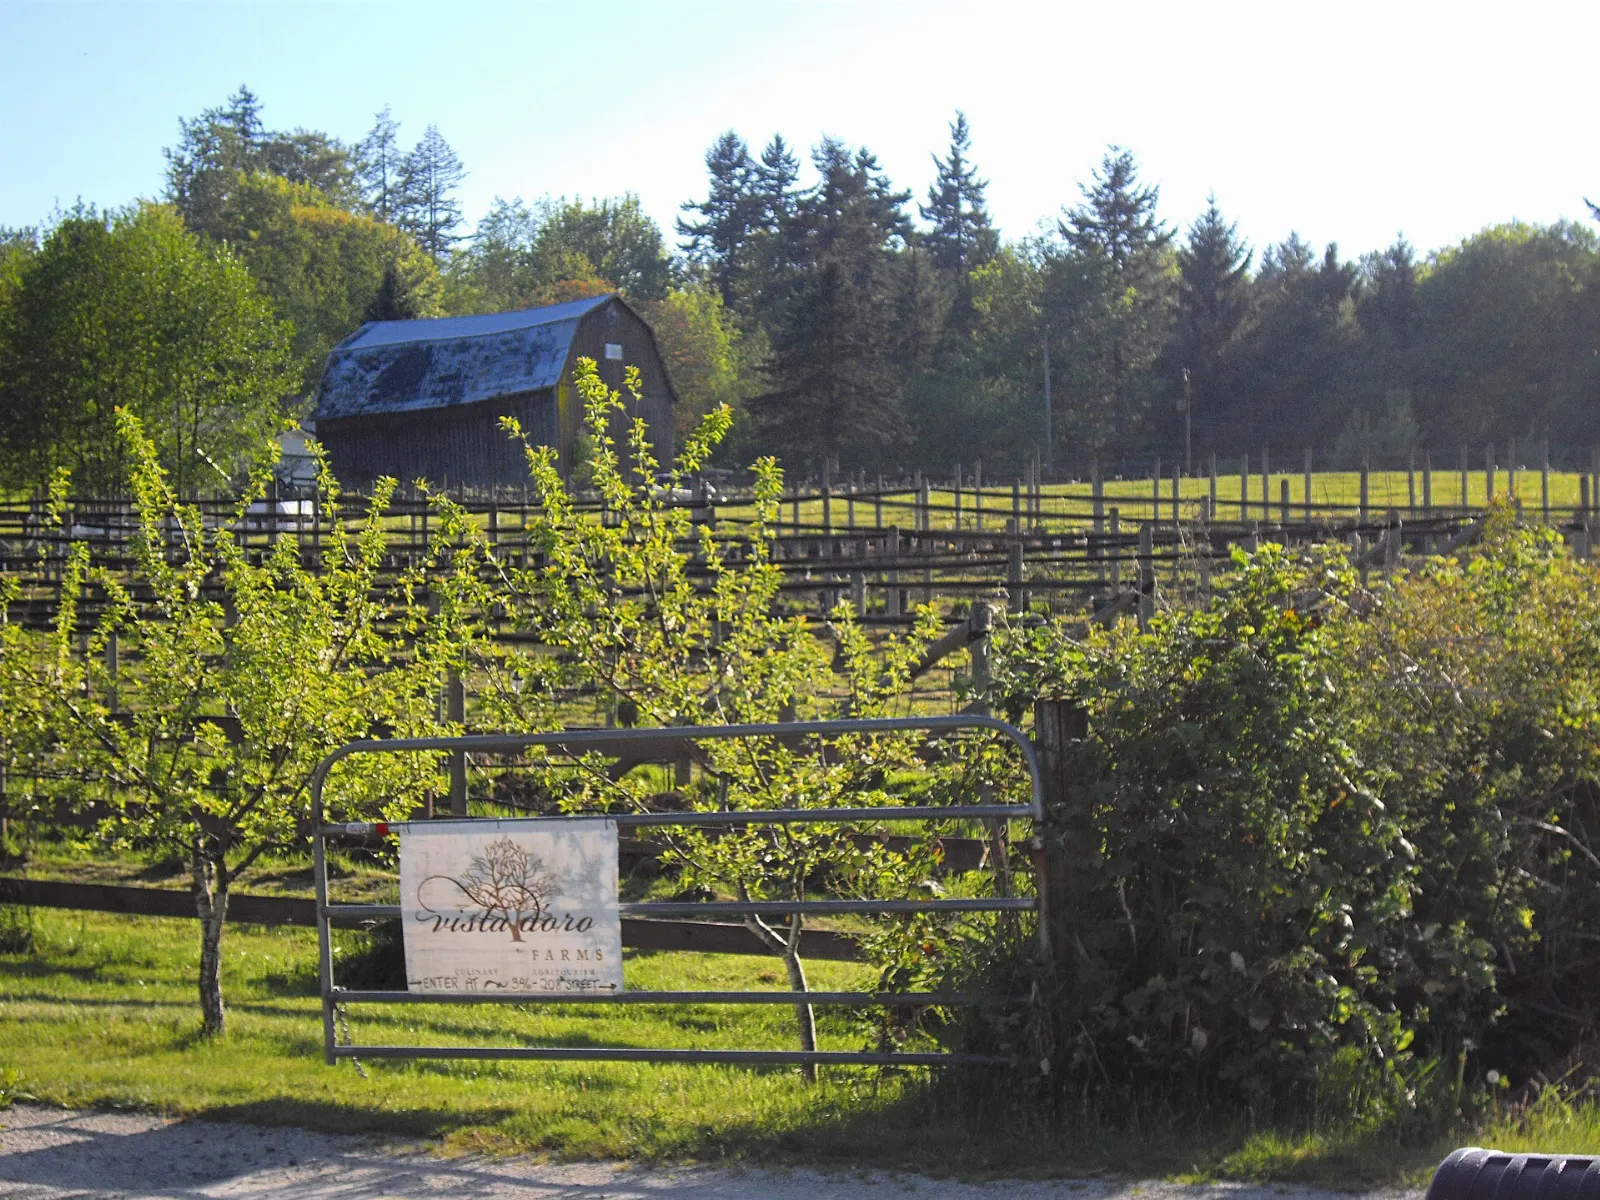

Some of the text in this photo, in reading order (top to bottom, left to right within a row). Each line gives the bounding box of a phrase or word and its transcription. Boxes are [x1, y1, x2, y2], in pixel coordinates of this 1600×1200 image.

[415, 882, 509, 933] vista
[531, 948, 604, 961] FARMS
[423, 976, 459, 989] ENTER
[465, 977, 479, 991] AT
[564, 979, 601, 990] STREET
